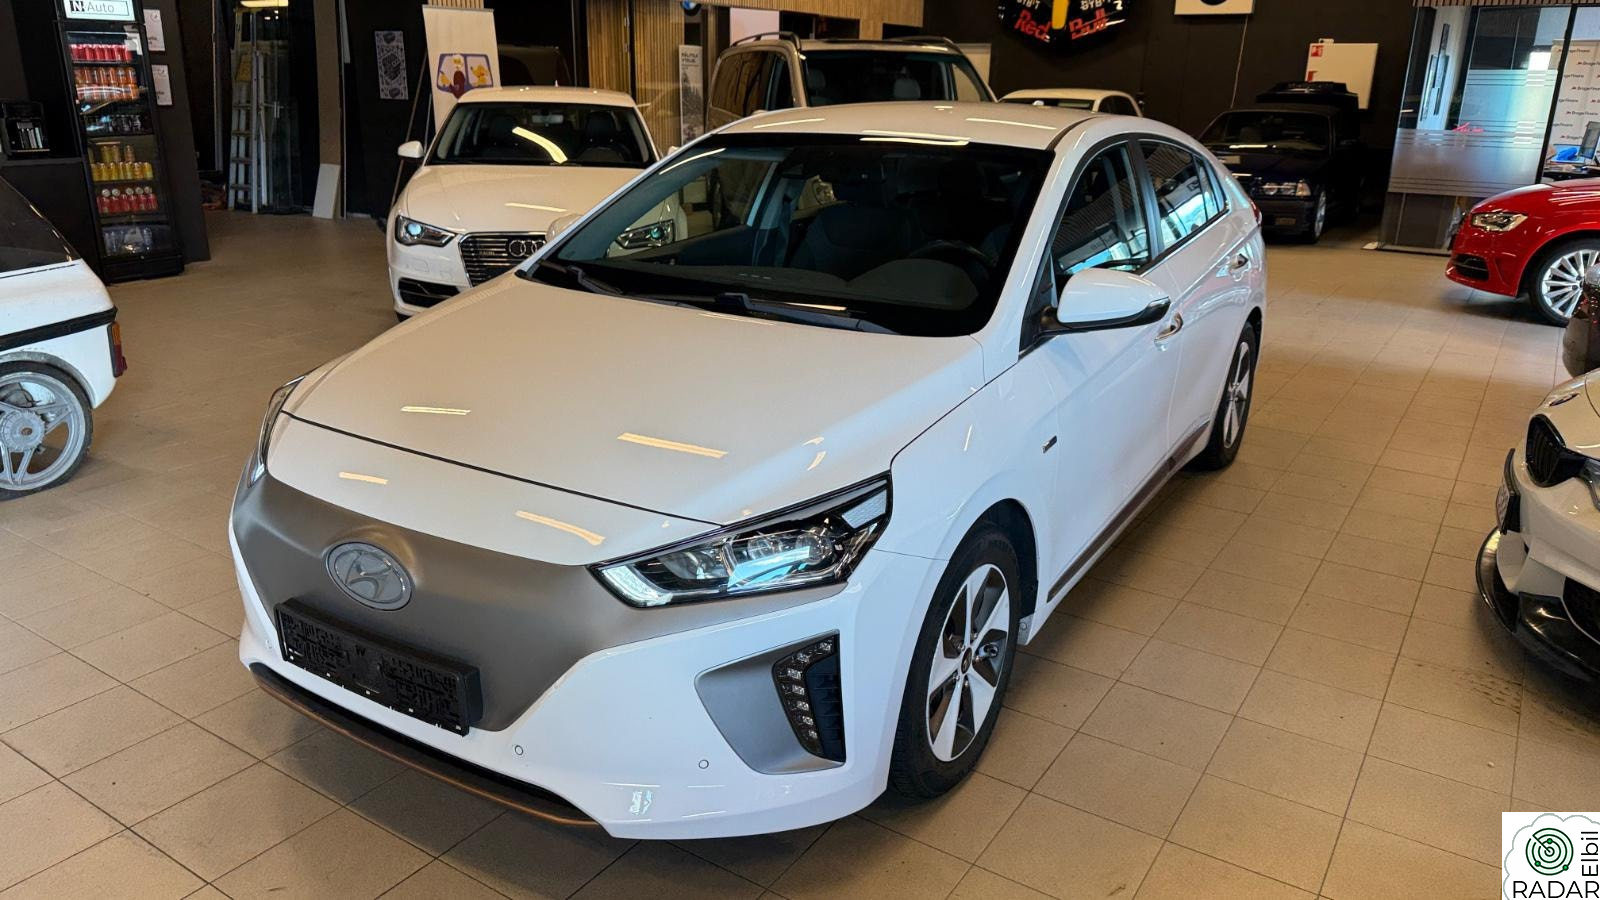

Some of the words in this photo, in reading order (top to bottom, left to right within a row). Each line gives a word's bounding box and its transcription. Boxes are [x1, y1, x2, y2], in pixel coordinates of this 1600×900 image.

[87, 2, 115, 13] Auto
[1013, 8, 1051, 41] Red
[1069, 8, 1108, 39] Bull
